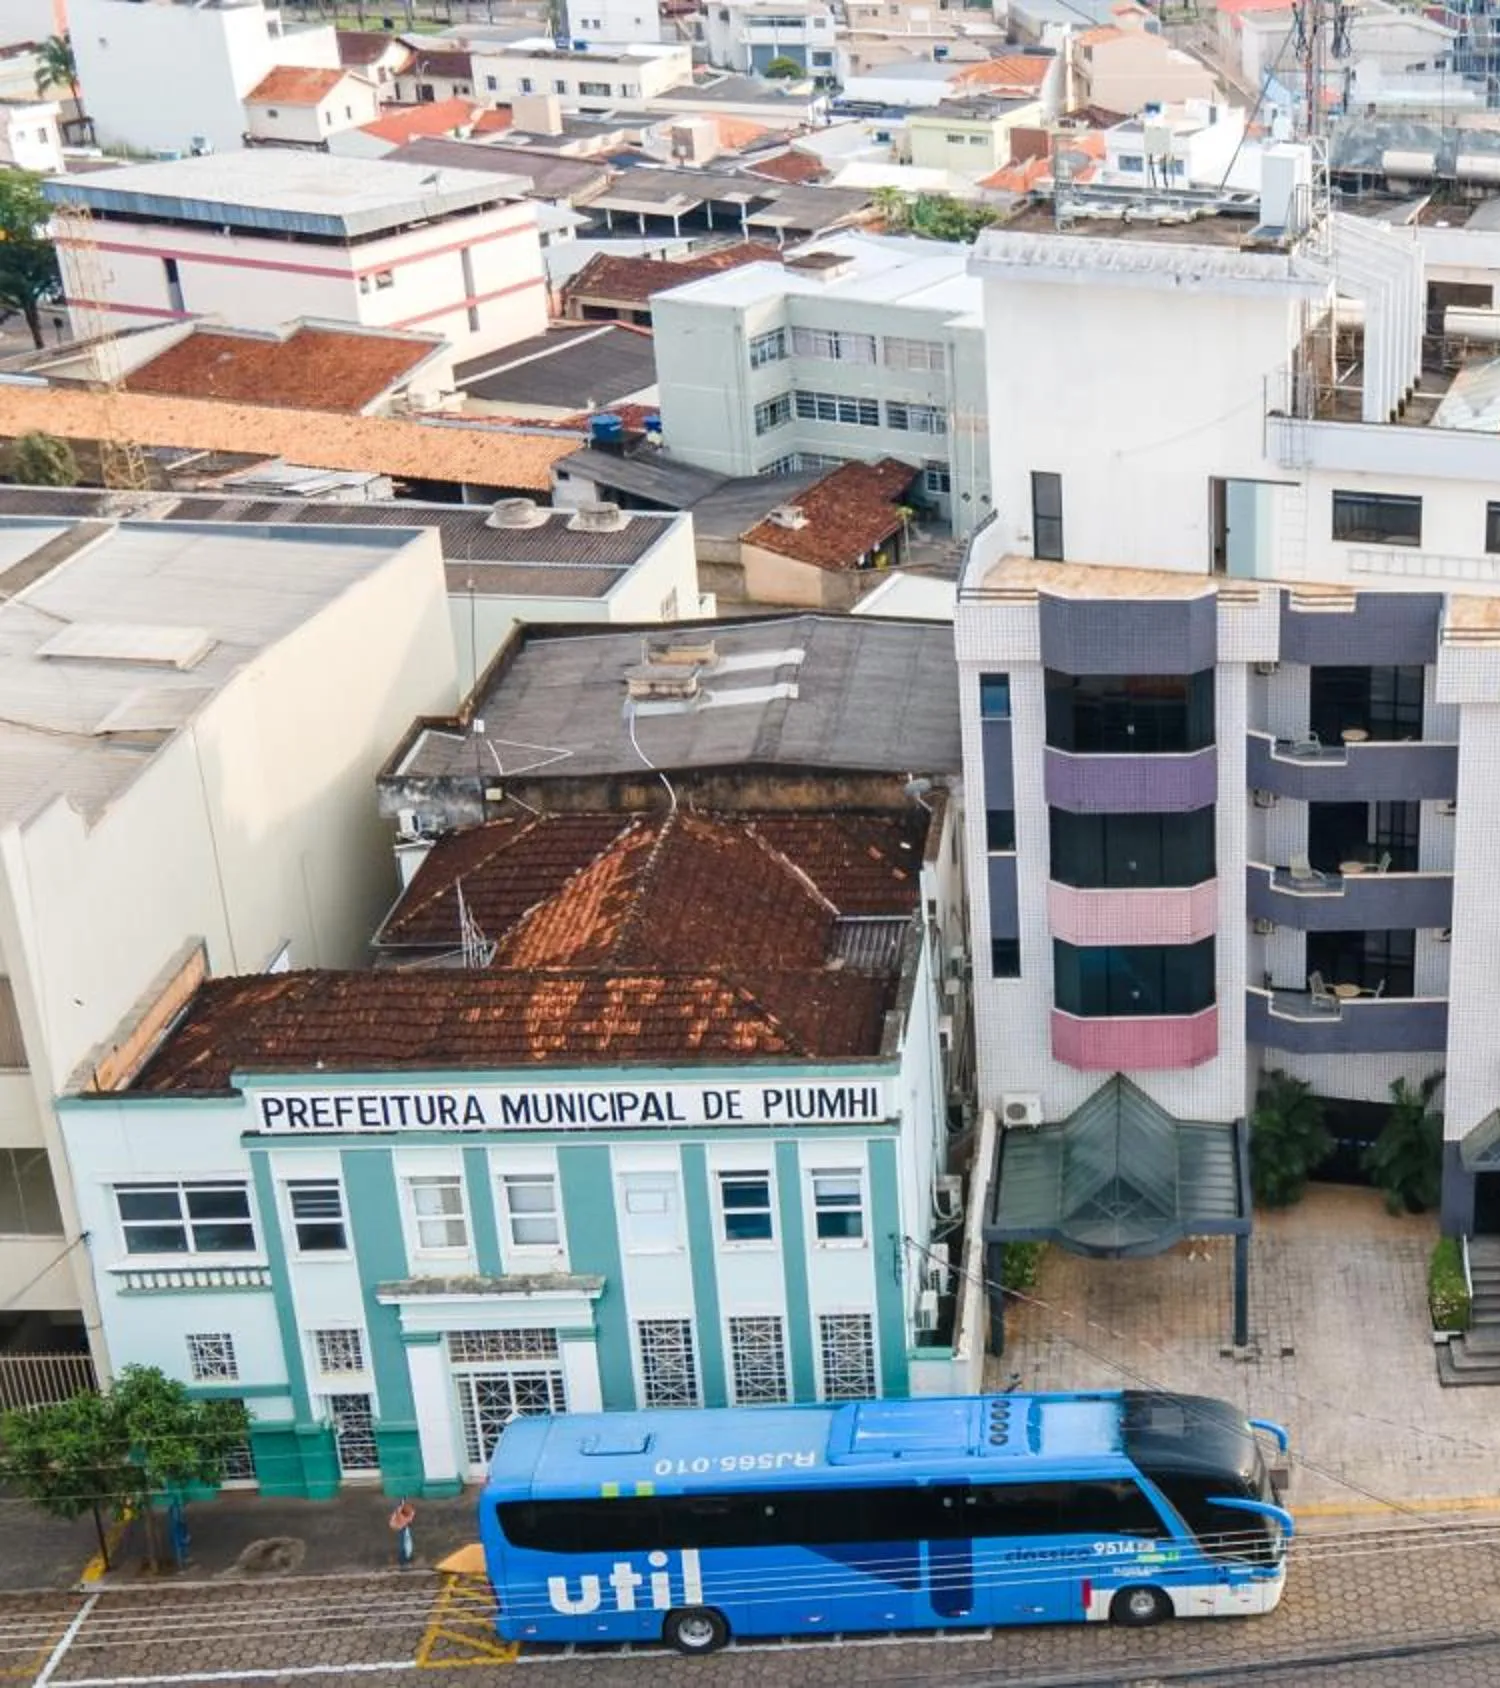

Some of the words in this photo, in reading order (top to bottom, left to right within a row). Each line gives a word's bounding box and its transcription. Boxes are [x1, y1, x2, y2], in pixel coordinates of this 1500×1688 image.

[260, 1095, 486, 1128] PREFEITURA
[499, 1091, 686, 1125] MUNICIPAL
[701, 1090, 744, 1120] DE
[762, 1087, 879, 1119] PIUMHI
[547, 1548, 703, 1615] util
